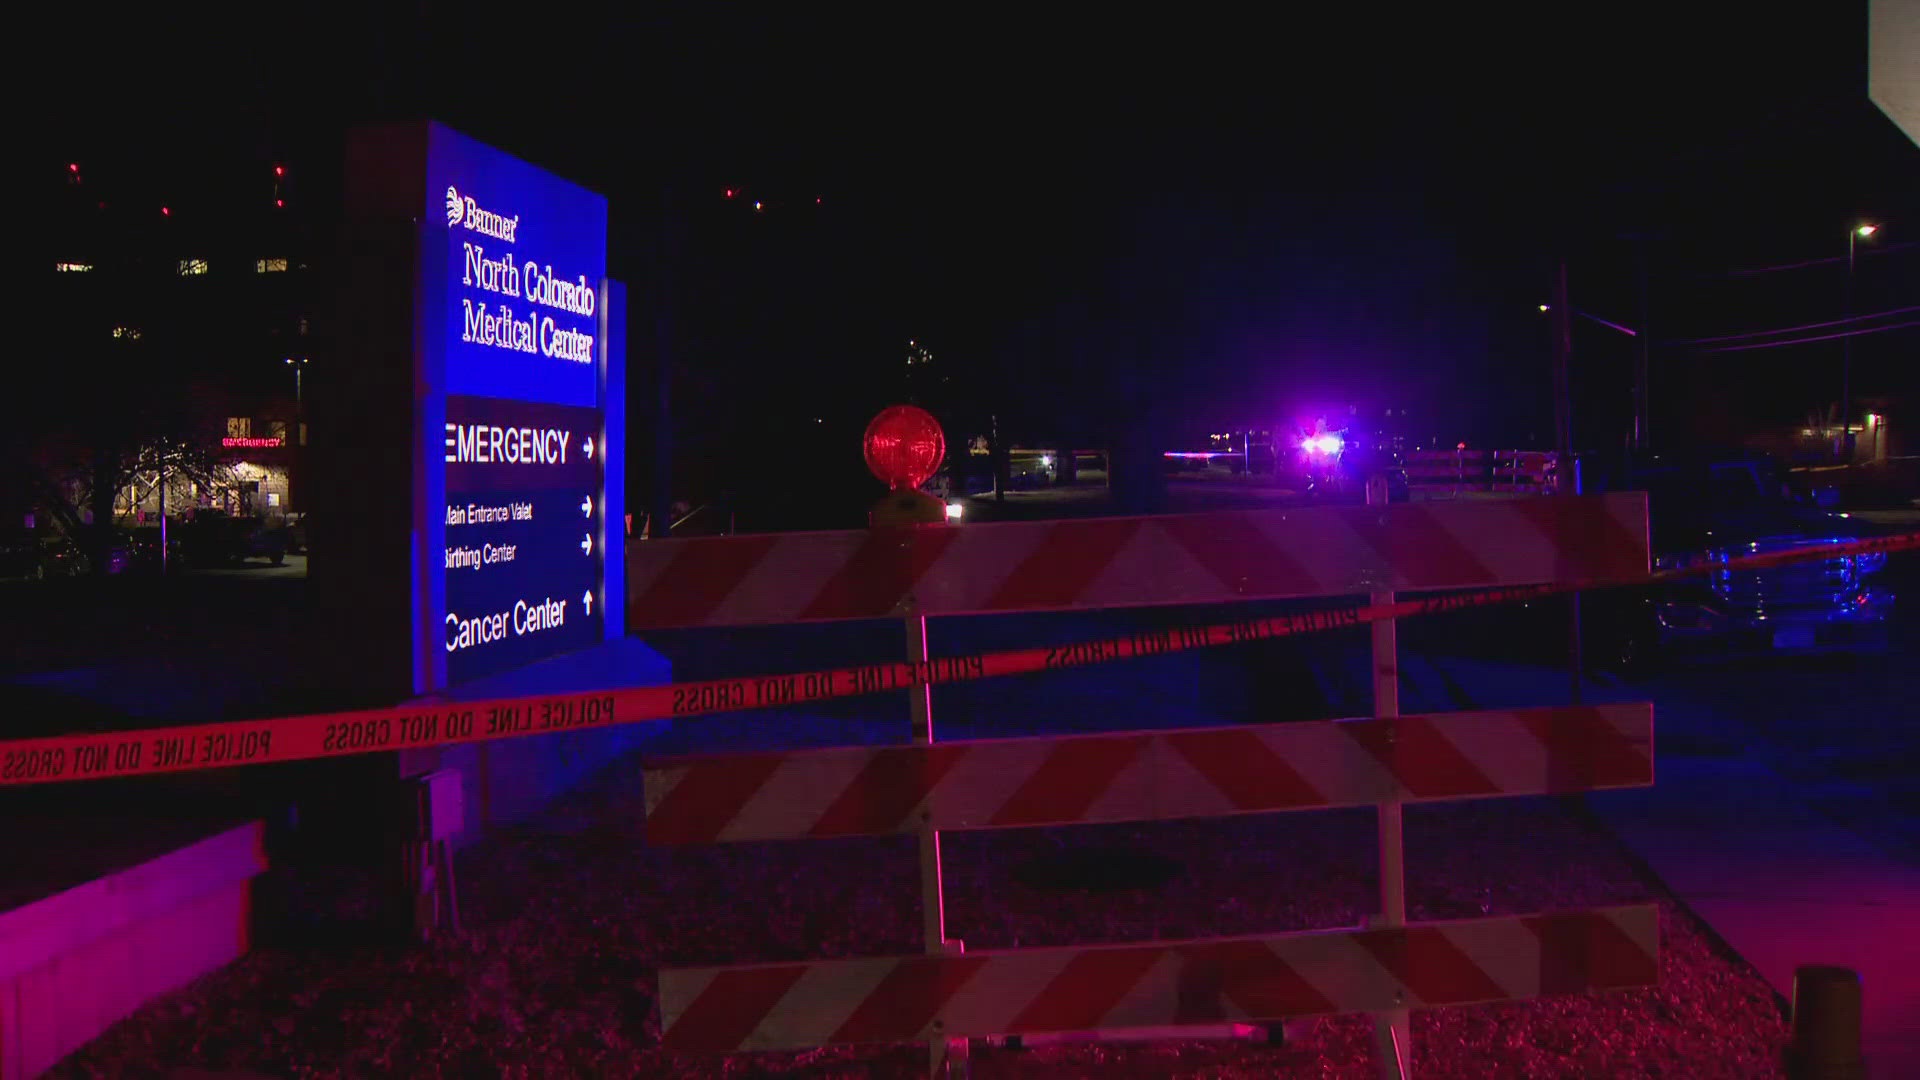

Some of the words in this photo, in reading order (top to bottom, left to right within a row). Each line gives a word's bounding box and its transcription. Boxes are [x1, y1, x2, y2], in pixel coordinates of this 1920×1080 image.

[463, 196, 518, 243] Banner
[462, 241, 520, 297] North
[523, 261, 595, 317] Colorado
[462, 299, 537, 354] Medical
[540, 317, 594, 364] Center
[445, 423, 570, 464] EMERGENCY
[483, 543, 516, 565] Center
[445, 612, 509, 651] Cancer
[513, 597, 566, 636] Center
